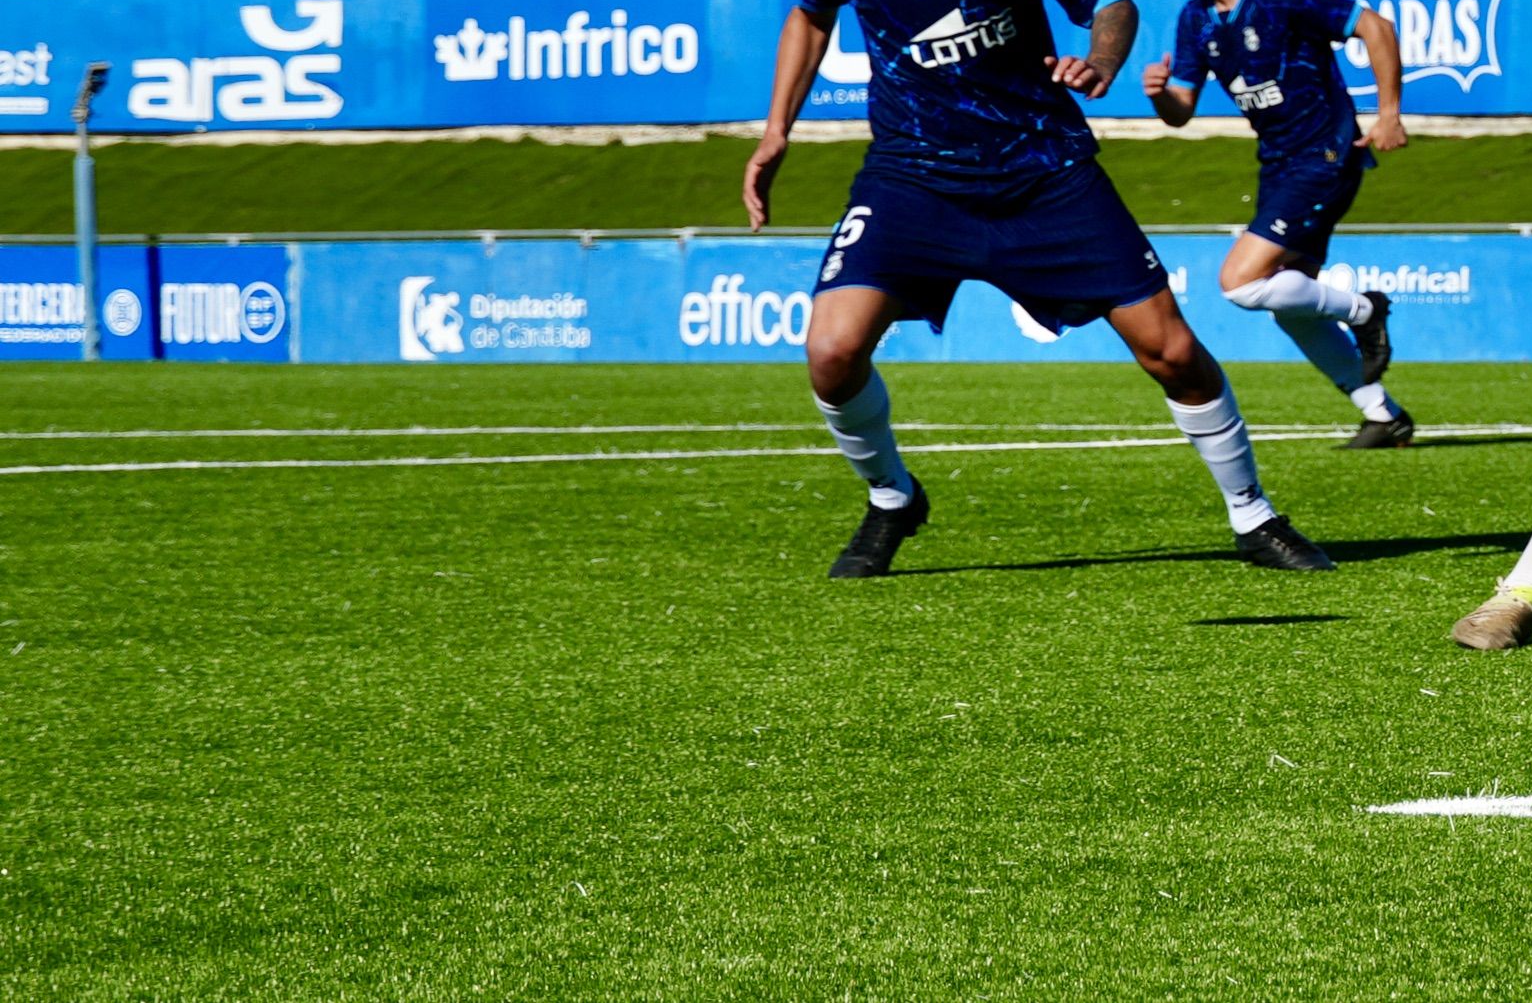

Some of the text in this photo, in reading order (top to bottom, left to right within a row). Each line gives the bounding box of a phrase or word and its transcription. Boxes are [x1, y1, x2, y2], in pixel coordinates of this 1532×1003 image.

[508, 9, 699, 81] Infrico
[909, 14, 1017, 69] LOTUS
[127, 53, 344, 122] aras
[834, 205, 873, 249] 5
[1357, 265, 1470, 294] Hofrical
[470, 292, 588, 324] Diputación
[470, 324, 500, 348] de
